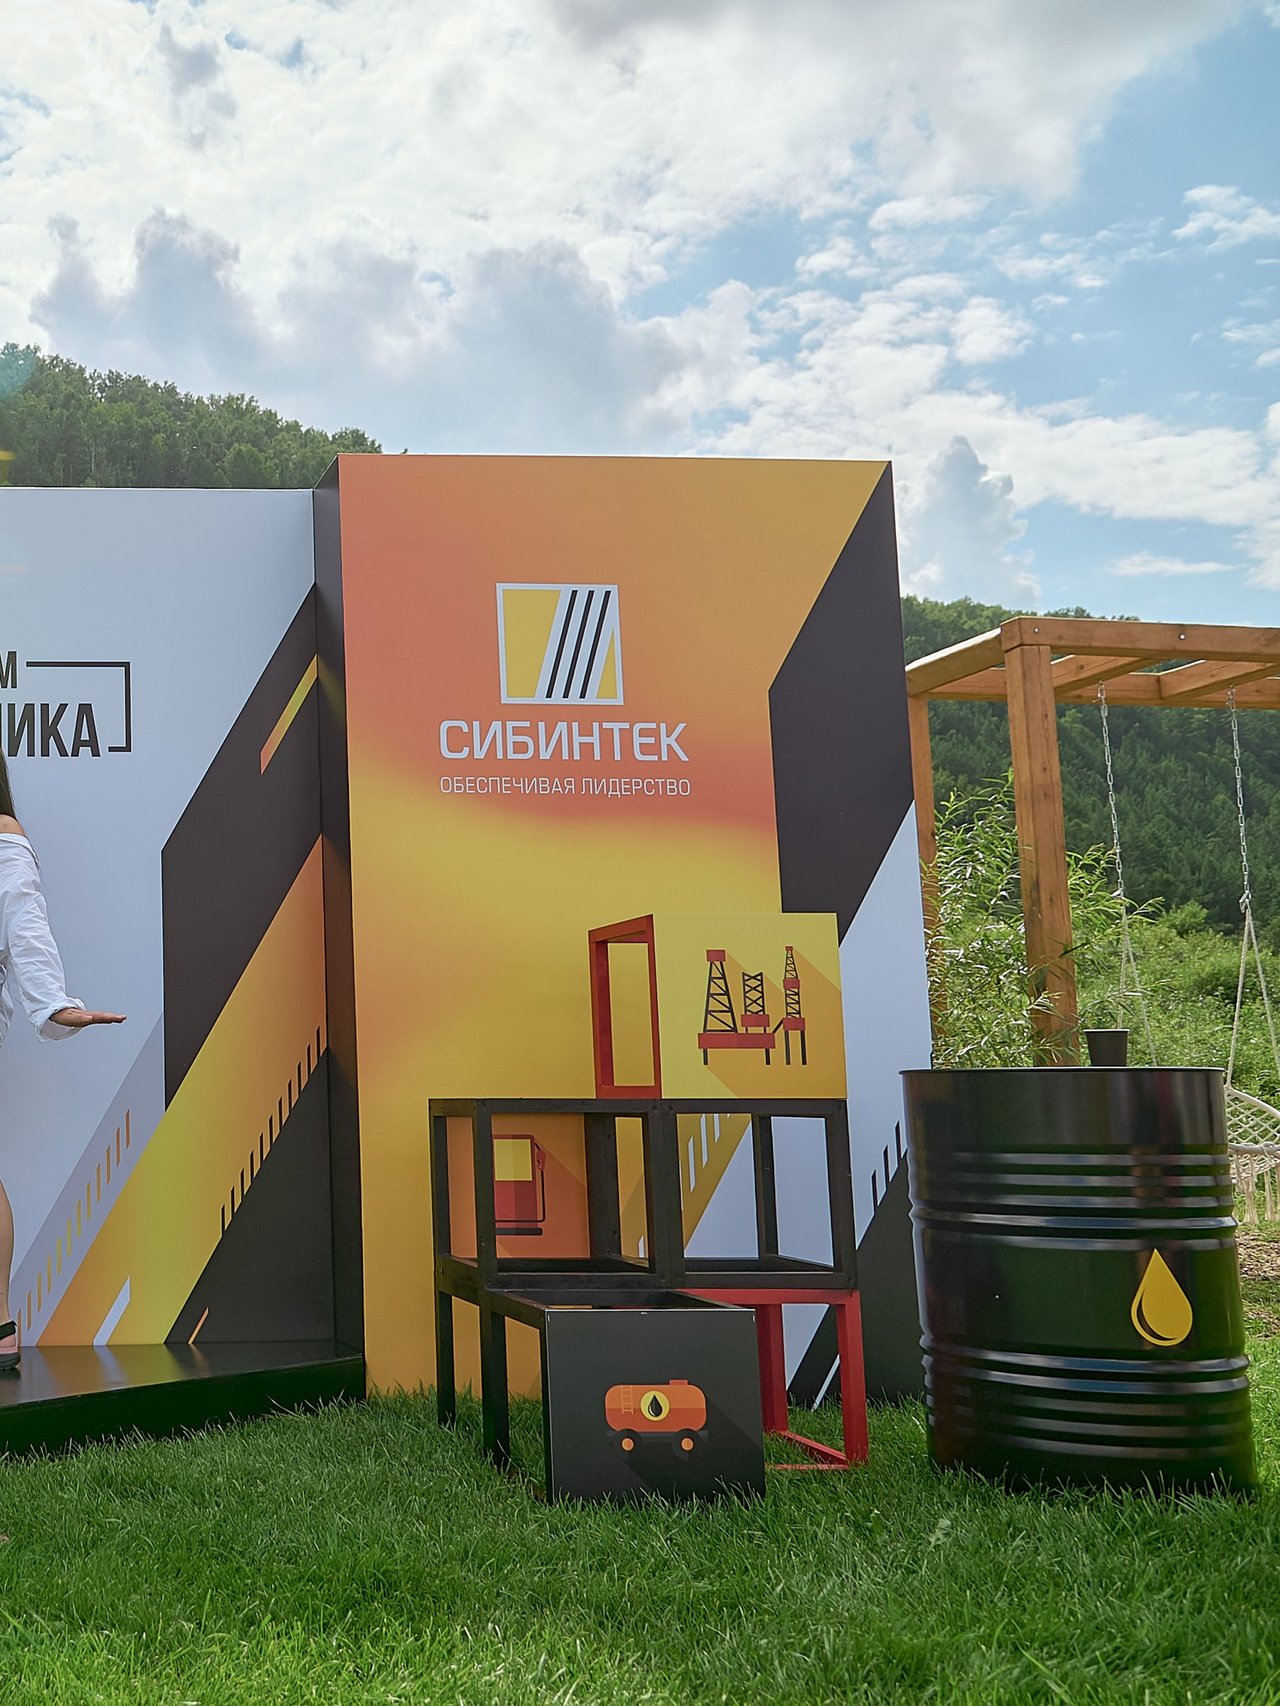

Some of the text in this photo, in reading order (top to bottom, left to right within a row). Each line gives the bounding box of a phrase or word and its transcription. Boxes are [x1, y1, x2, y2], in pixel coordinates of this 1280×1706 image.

[439, 720, 690, 762] СИБИНТЕК
[440, 776, 691, 798] ОБЕСПЕЧИВАЯ ЛИДЕРСТВО
